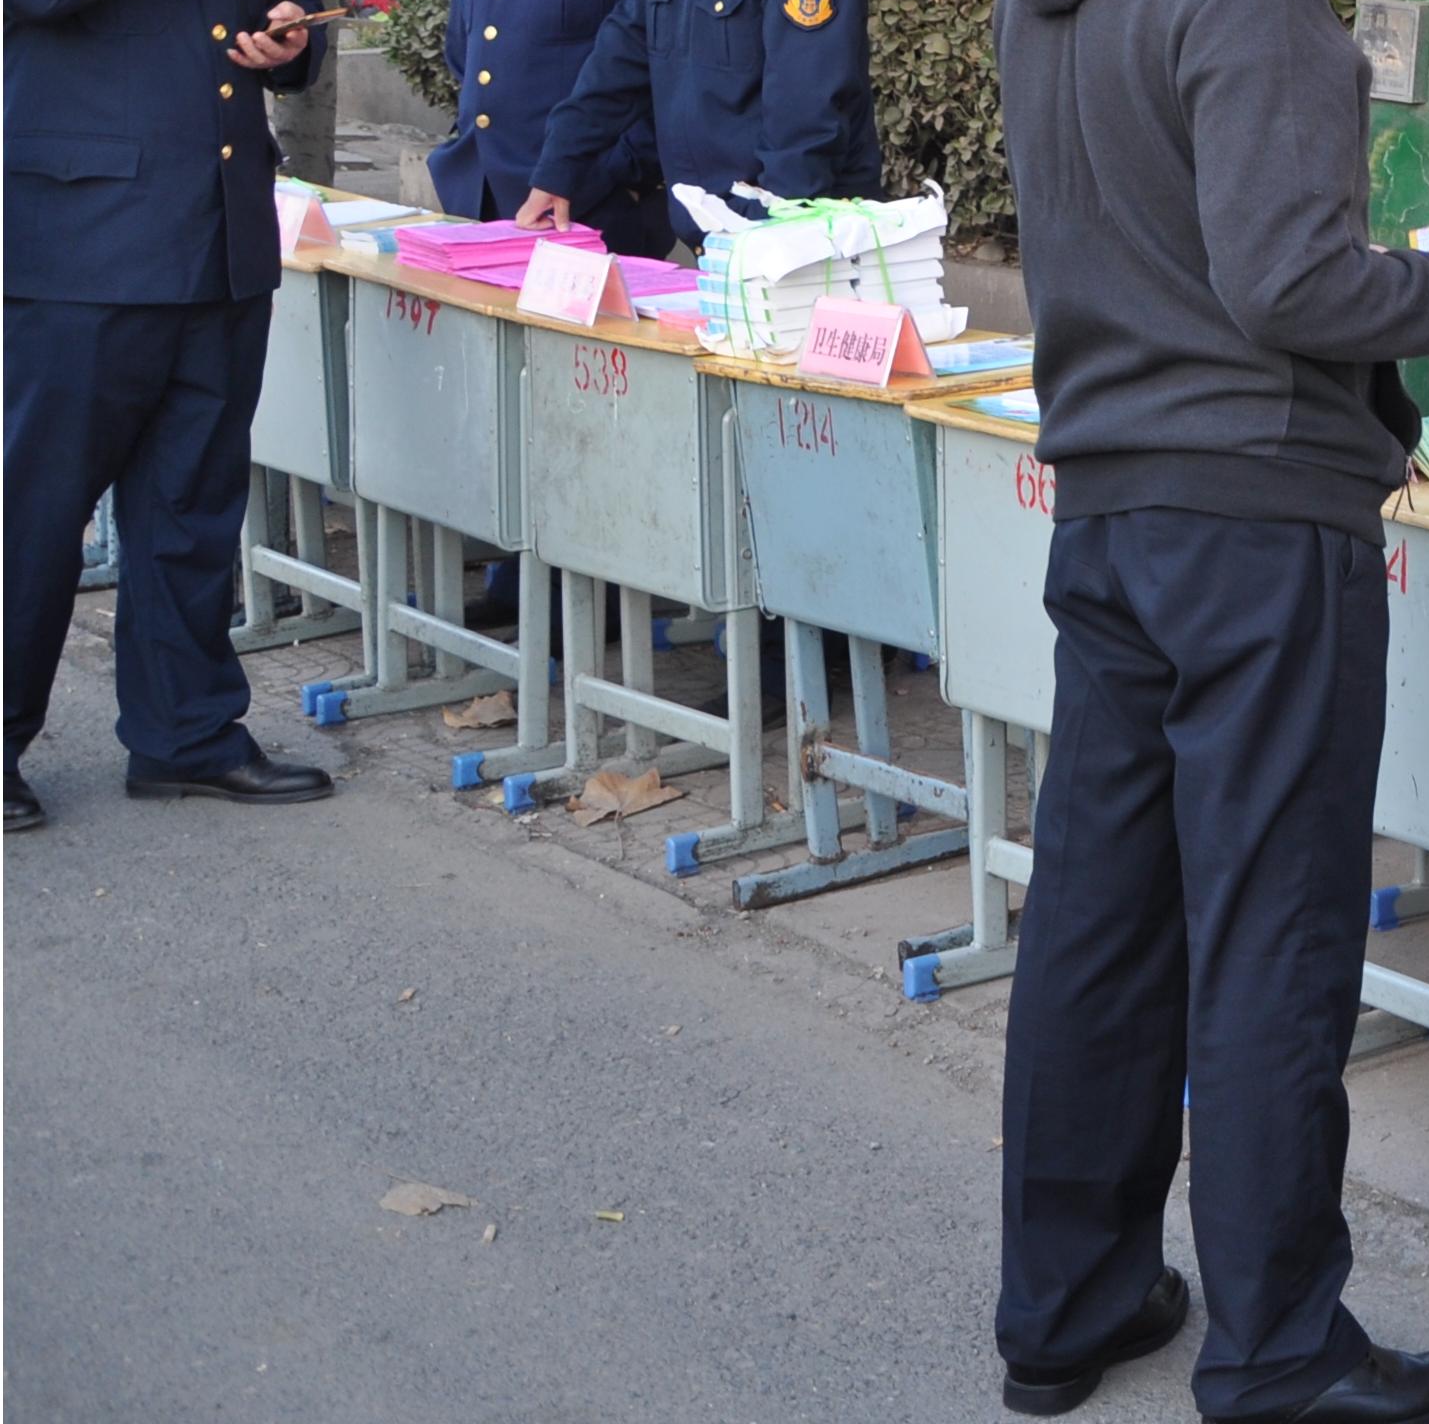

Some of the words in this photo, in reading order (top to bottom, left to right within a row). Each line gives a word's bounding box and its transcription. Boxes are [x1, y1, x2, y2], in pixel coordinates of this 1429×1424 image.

[574, 343, 629, 397] 538
[811, 327, 888, 367] 卫生健康局
